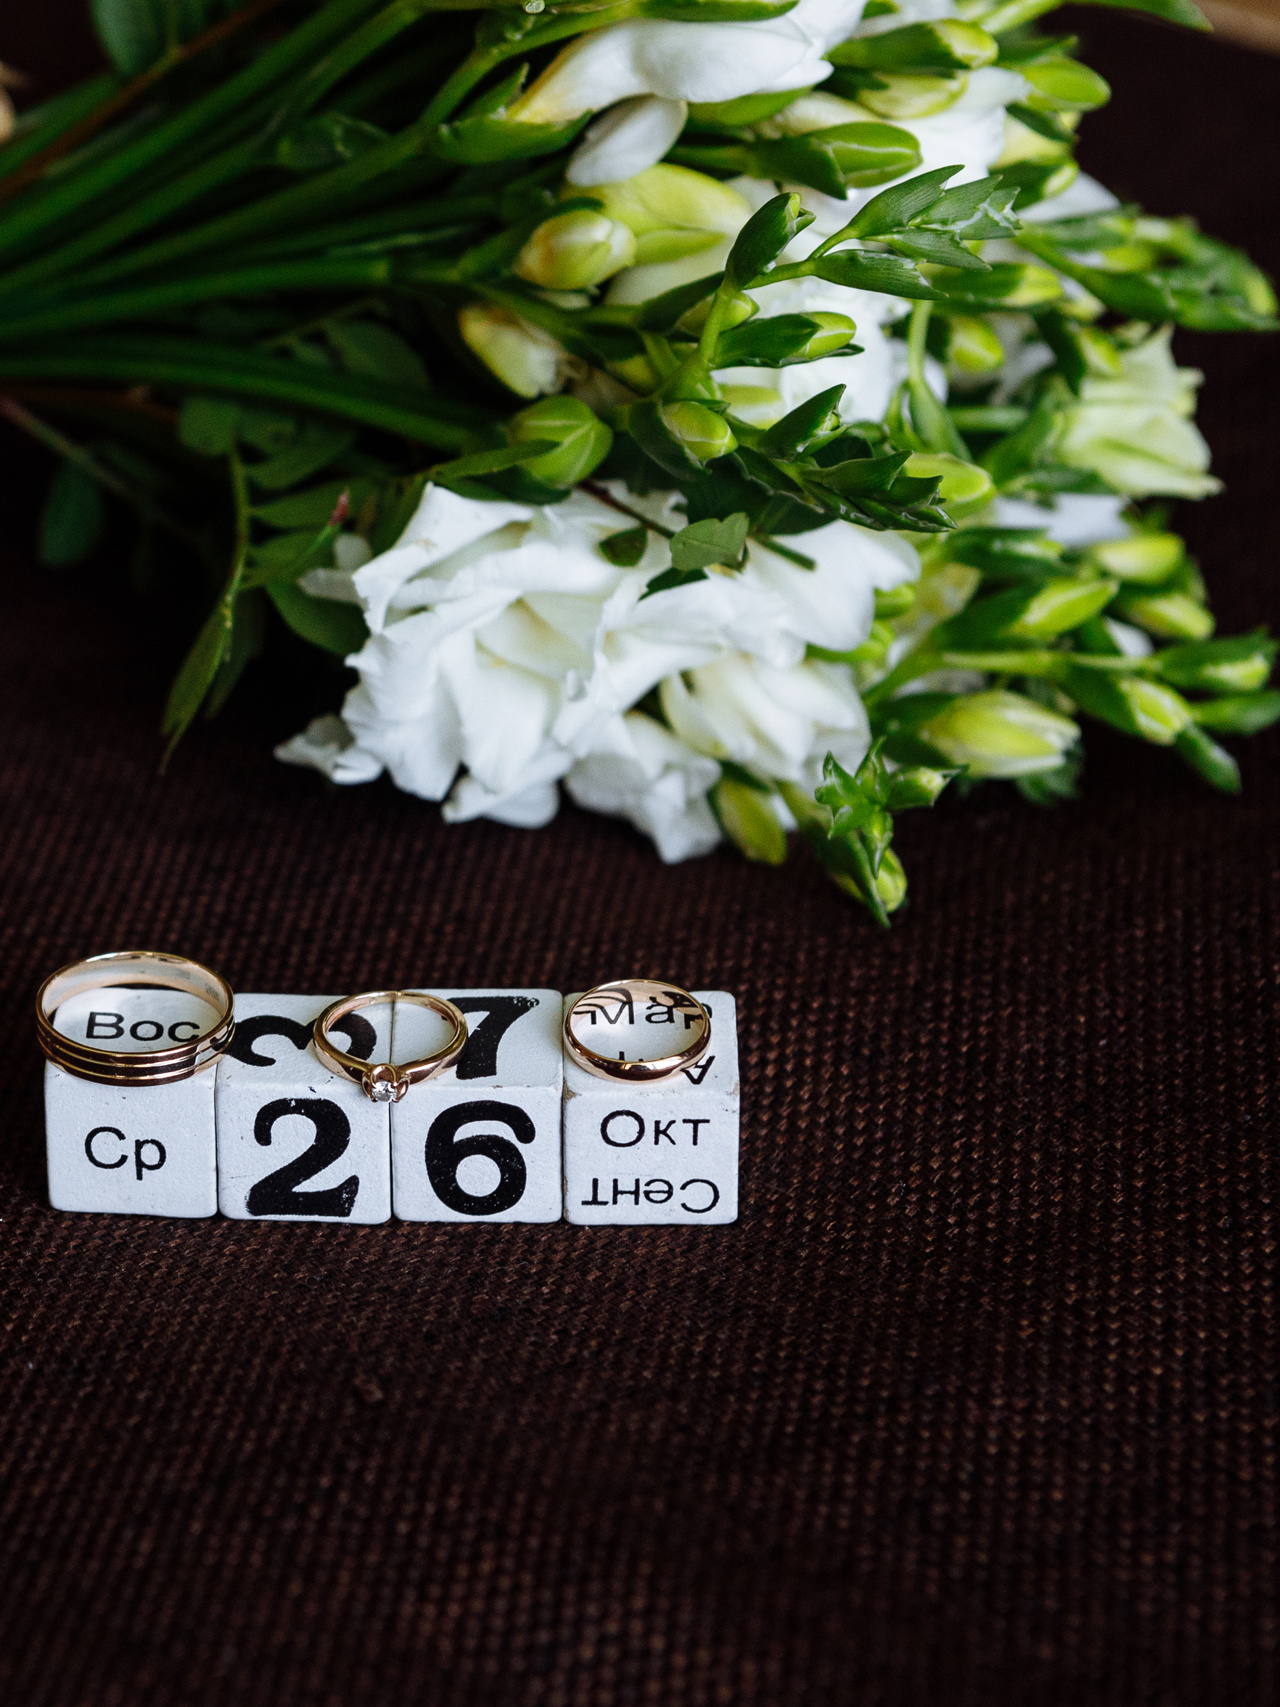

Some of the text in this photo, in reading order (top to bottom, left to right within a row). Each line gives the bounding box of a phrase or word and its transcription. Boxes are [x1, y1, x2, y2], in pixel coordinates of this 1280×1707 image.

[85, 1011, 201, 1043] Вос
[441, 995, 540, 1080] 7
[84, 1126, 167, 1181] Ср
[600, 1109, 711, 1148] Окт
[581, 1177, 720, 1214] Сент
